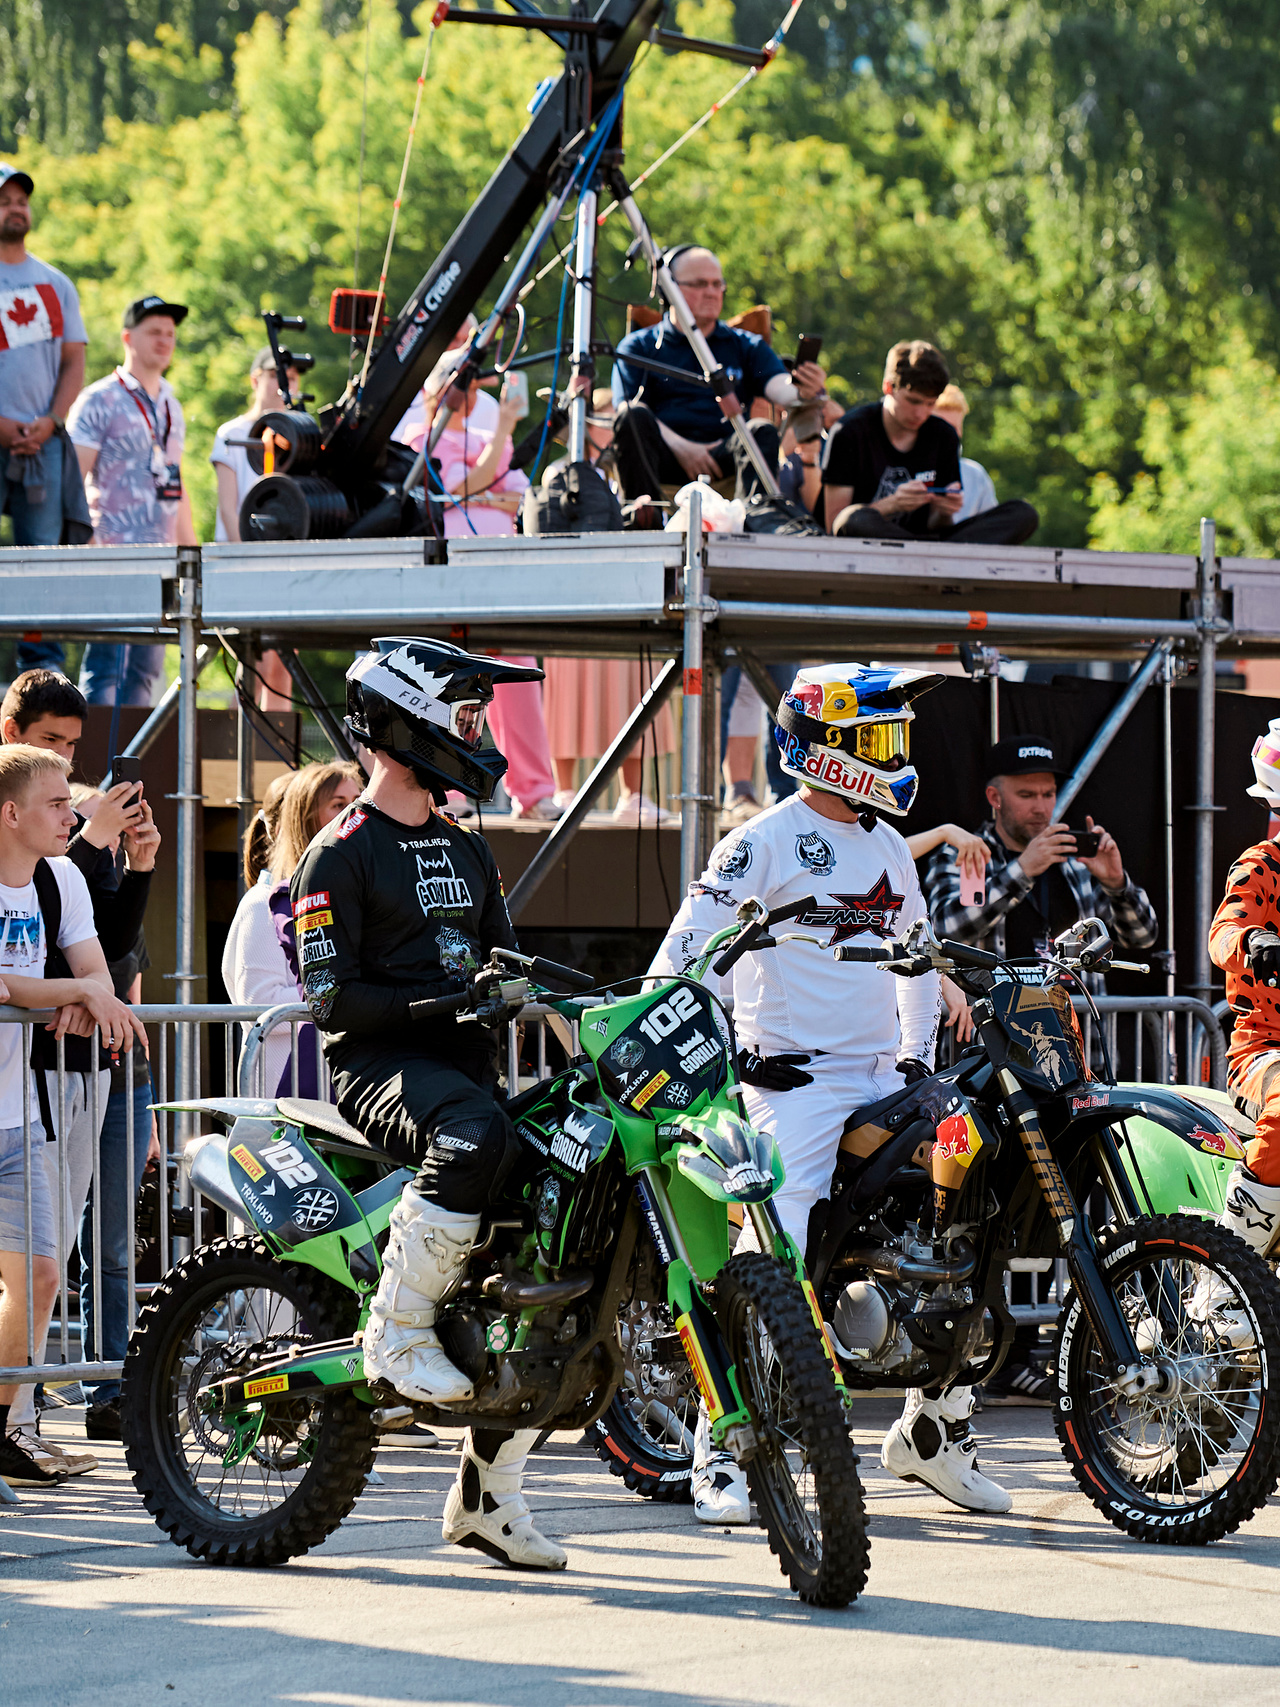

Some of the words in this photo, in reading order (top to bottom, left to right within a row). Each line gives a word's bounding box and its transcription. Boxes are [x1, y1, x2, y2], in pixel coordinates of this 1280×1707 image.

[399, 691, 432, 712] FOX
[784, 732, 825, 775] Red
[823, 758, 875, 796] Bull
[336, 811, 366, 839] MOTUL
[408, 838, 451, 849] TRAILHEAD
[295, 893, 328, 915] MOTUL
[301, 940, 335, 963] ORILLA
[639, 986, 703, 1046] 102
[680, 1037, 722, 1075] GORILLA
[619, 1070, 650, 1104] TRXLHXD
[635, 1074, 667, 1107] PIRELLI
[1072, 1098, 1090, 1110] Red
[1091, 1094, 1109, 1107] Bull
[234, 1147, 262, 1178] PIRELLI
[259, 1140, 318, 1189] 102
[550, 1131, 590, 1173] GORILLA
[722, 1170, 776, 1195] GORILLA
[1048, 1162, 1074, 1217] RACING
[240, 1183, 274, 1225] TRXLHXD
[647, 1209, 671, 1263] RACING
[249, 1378, 284, 1396] PIRELLI
[1109, 1500, 1214, 1527] DUNLOP
